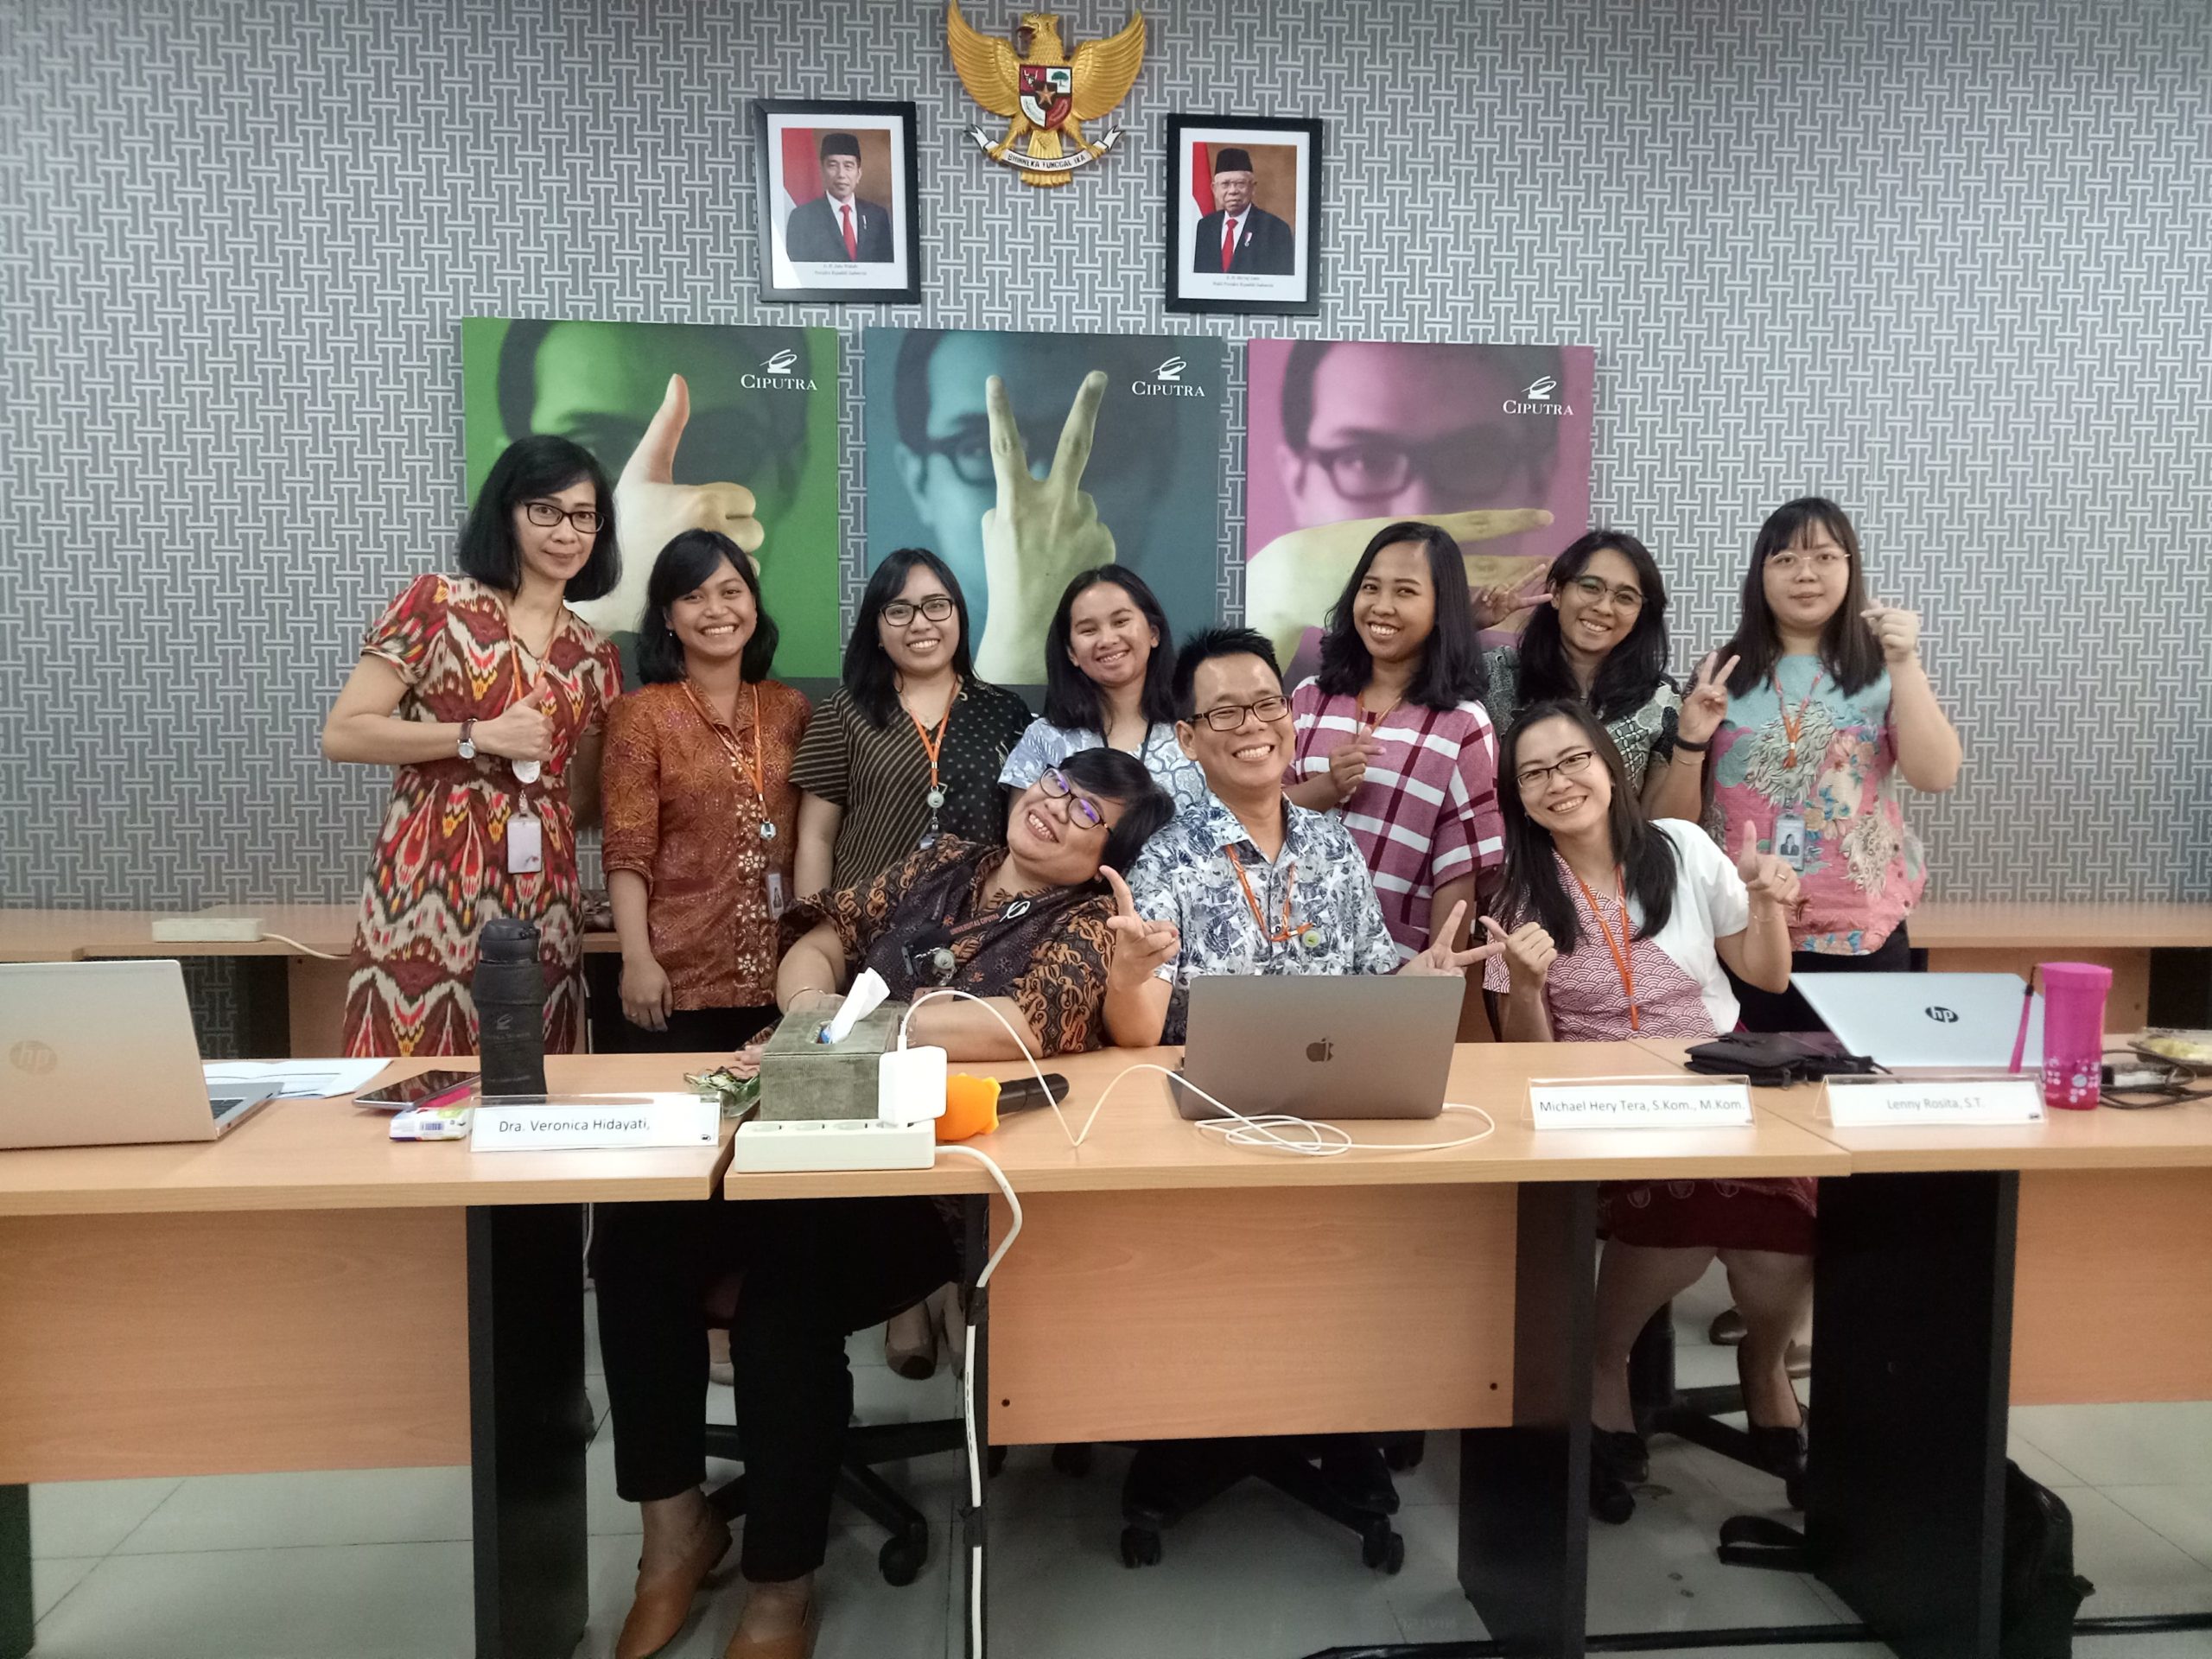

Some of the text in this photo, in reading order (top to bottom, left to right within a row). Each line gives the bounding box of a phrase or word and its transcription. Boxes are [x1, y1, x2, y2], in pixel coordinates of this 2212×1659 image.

[1074, 154, 1086, 163] IKA
[1928, 1006, 1956, 1023] hp
[15, 1040, 53, 1073] hp
[1539, 1100, 1586, 1112] Michael
[1589, 1101, 1617, 1113] Hery
[1619, 1100, 1650, 1112] Tera,
[1886, 1098, 1921, 1111] Lenny
[1923, 1097, 1962, 1110] Rosita,
[499, 1120, 524, 1133] Dra.
[530, 1119, 589, 1132] Veronica
